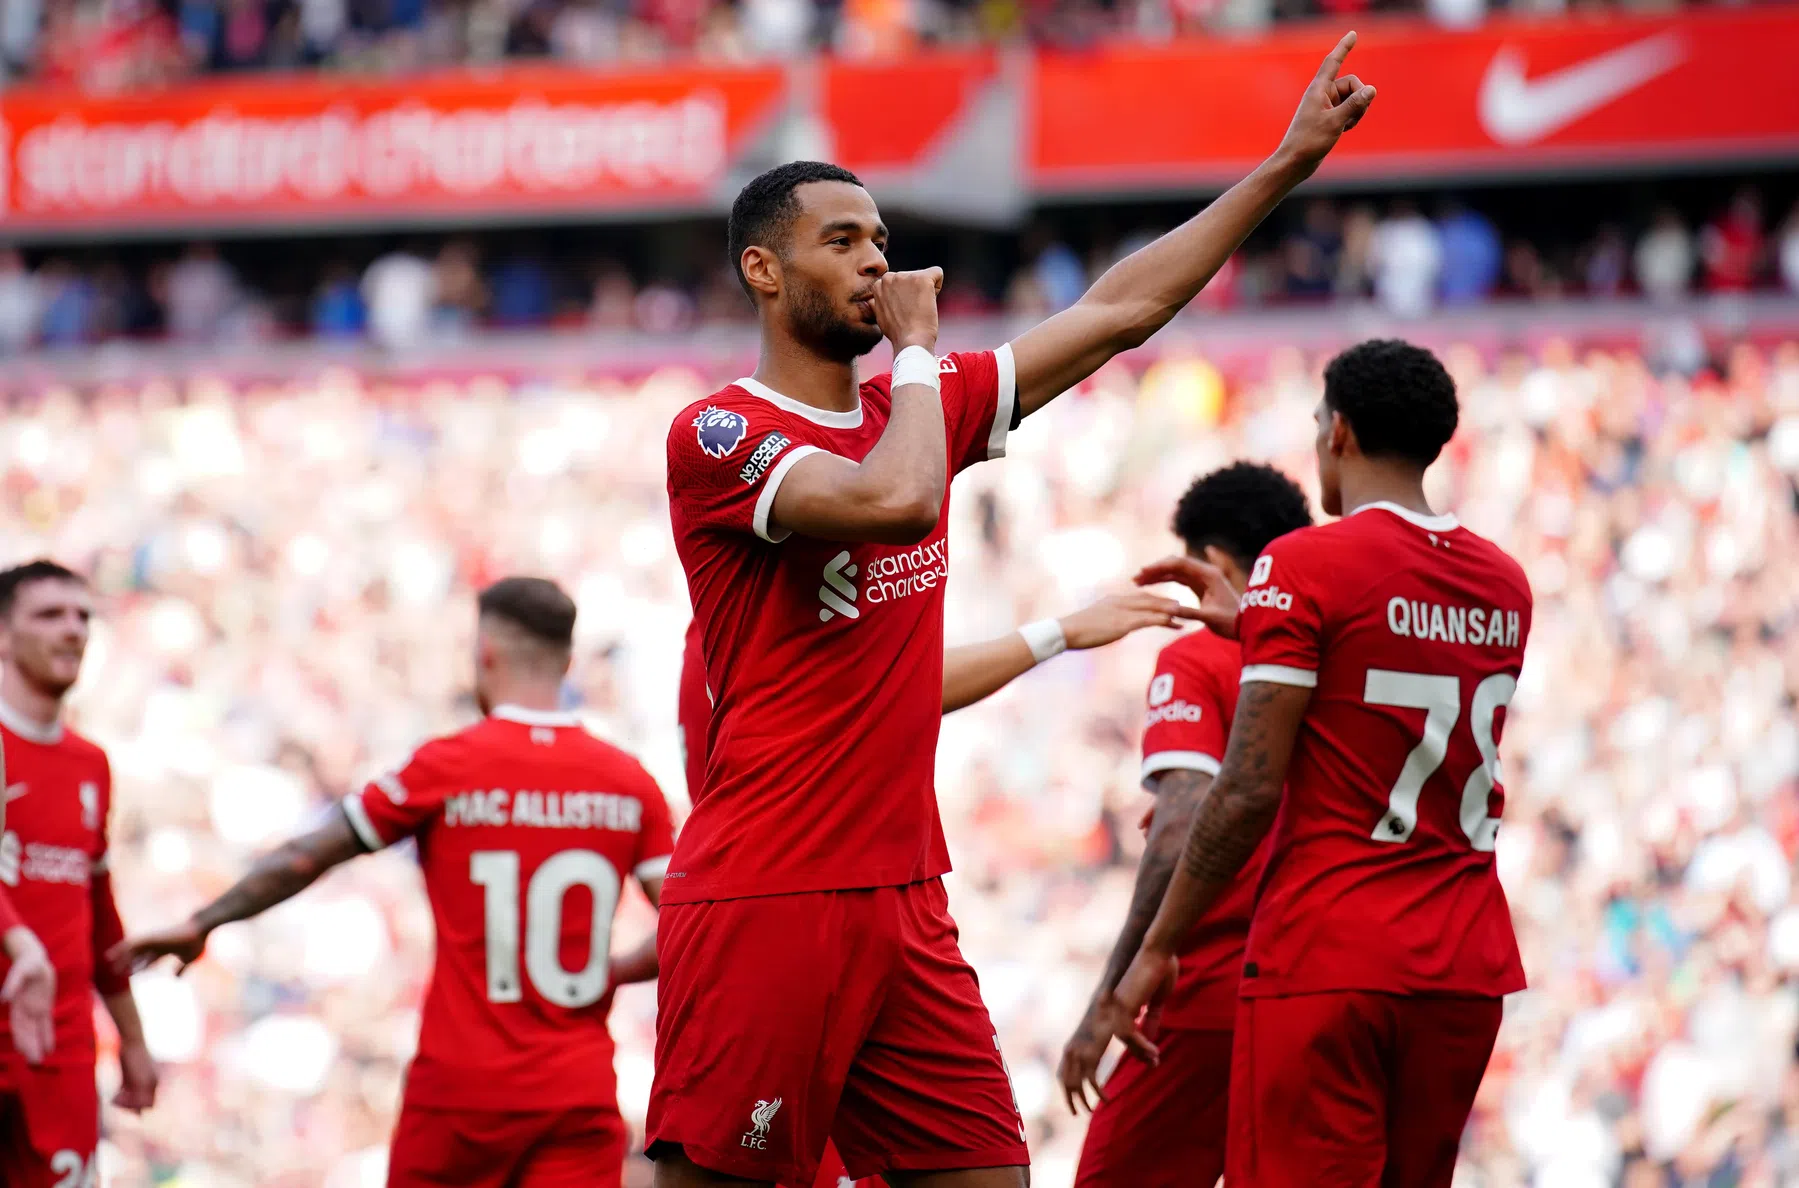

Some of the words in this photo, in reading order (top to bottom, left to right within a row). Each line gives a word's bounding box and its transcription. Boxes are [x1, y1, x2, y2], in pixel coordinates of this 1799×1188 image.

[740, 464, 754, 483] No
[750, 435, 779, 465] room
[757, 438, 791, 472] racism
[1240, 585, 1293, 614] pedia
[1387, 596, 1520, 648] QUANSAH
[1363, 668, 1518, 852] 78
[444, 788, 509, 827] MAC
[512, 789, 643, 833] ALLISTER
[469, 850, 621, 1008] 10
